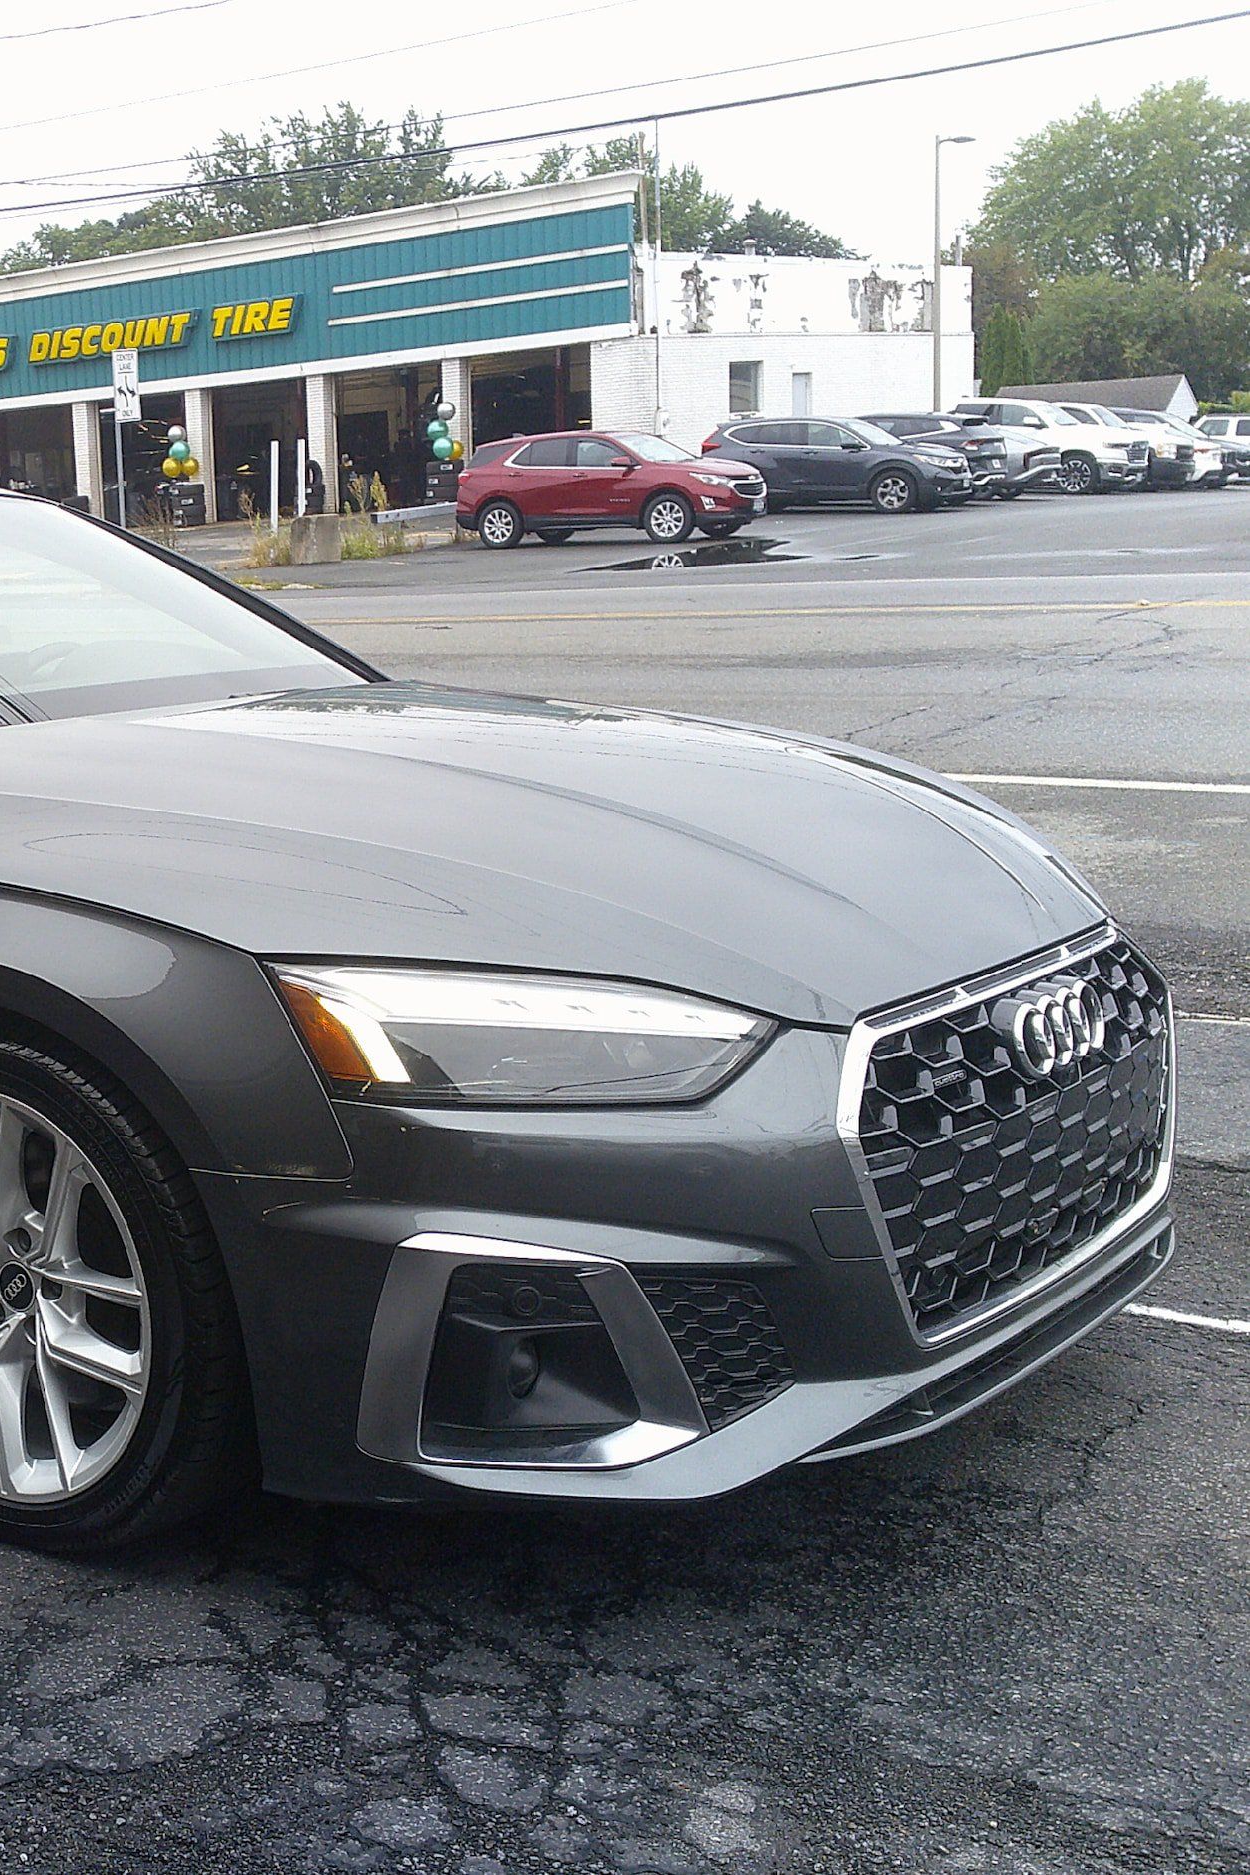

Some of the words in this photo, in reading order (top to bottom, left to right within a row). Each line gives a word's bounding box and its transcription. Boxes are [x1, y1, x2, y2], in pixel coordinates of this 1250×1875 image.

[28, 313, 192, 362] DISCOUNT
[211, 297, 294, 338] TIRE
[116, 353, 135, 361] CENTER
